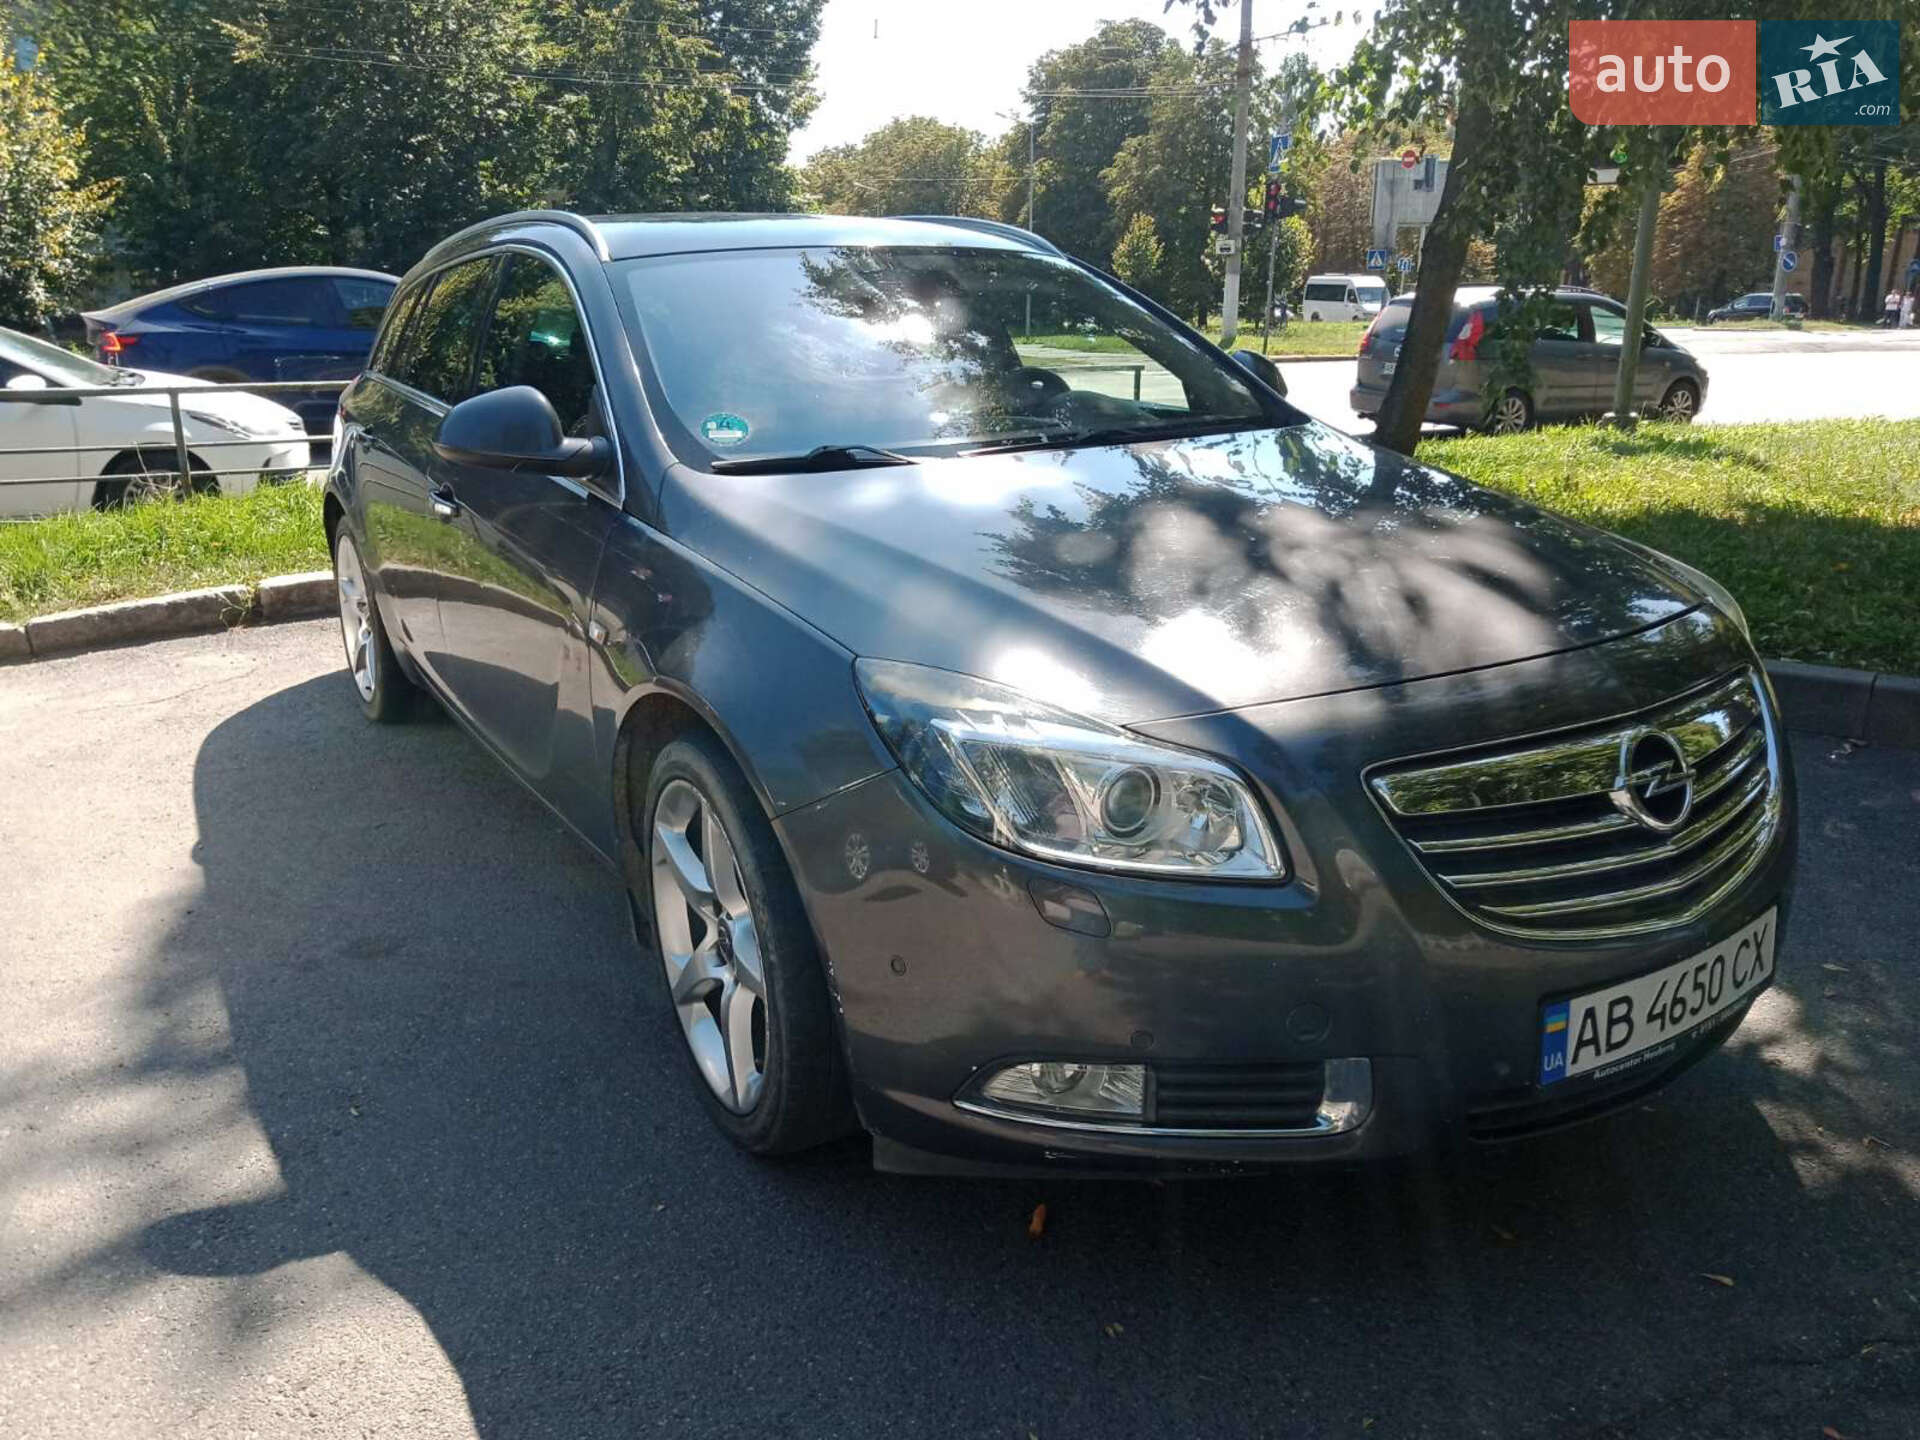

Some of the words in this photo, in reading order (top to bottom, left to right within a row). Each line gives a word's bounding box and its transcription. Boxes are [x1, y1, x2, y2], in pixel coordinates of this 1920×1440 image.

[1571, 995, 1634, 1065] AB
[1646, 954, 1725, 1032] 4650
[1732, 922, 1768, 990] CX
[1543, 1052, 1565, 1071] UA
